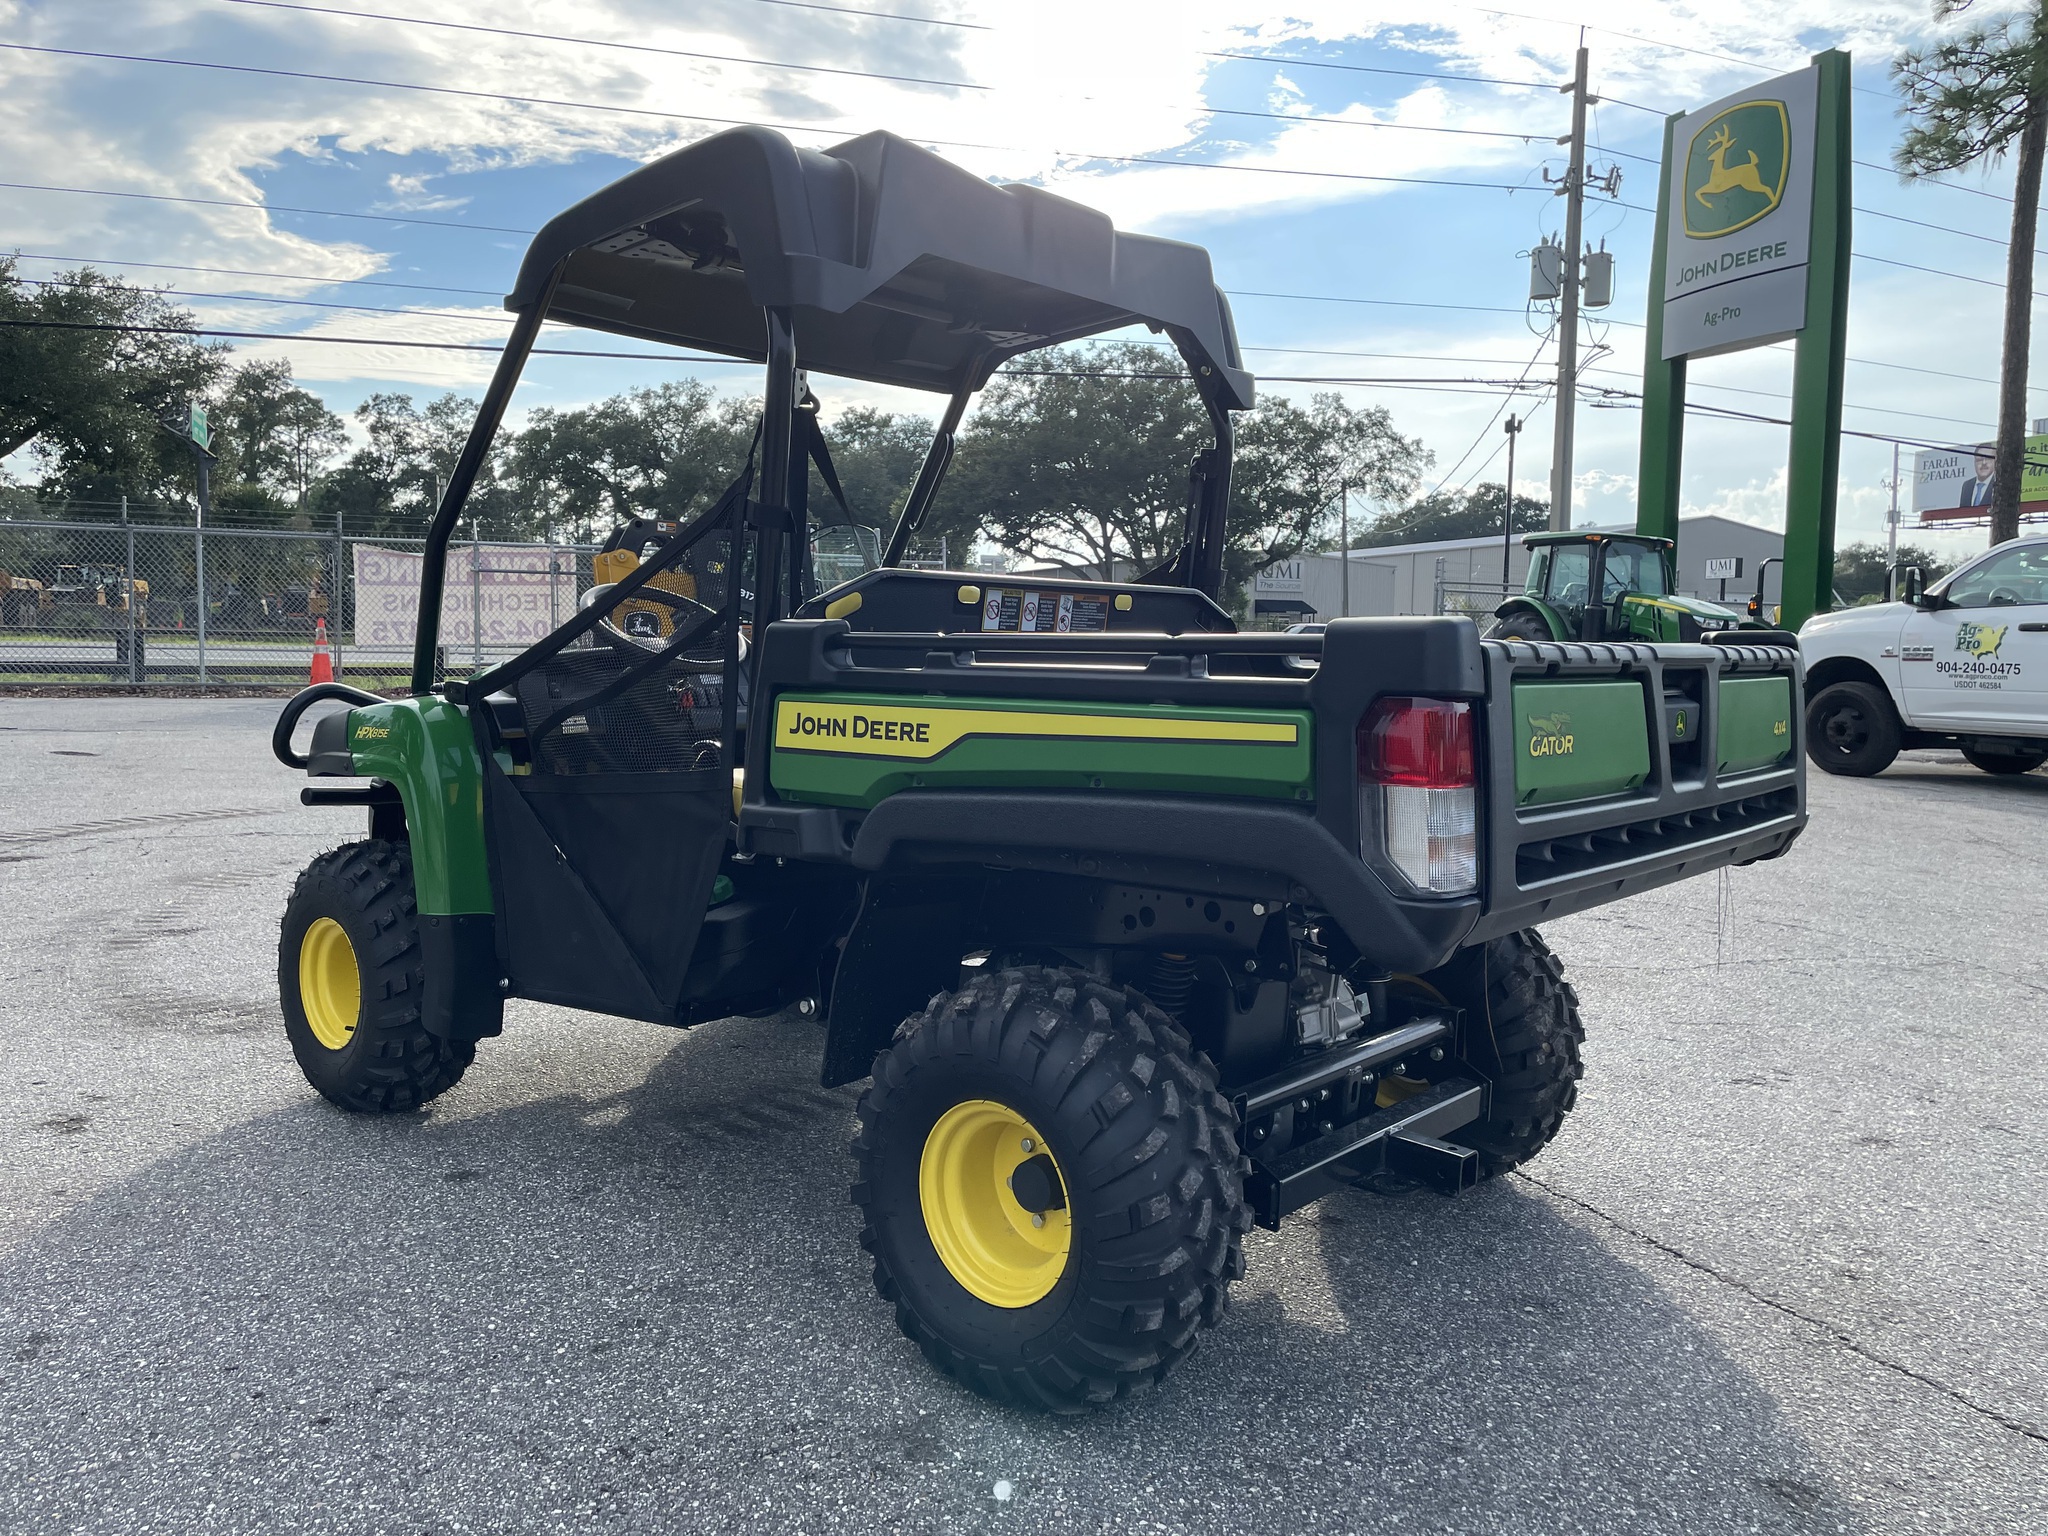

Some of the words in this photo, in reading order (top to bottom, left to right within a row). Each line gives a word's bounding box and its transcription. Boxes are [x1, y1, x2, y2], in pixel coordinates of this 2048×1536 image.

[1676, 260, 1717, 287] JOHN
[1720, 241, 1787, 272] DEERE
[1704, 307, 1741, 326] Ag-Pro
[1923, 457, 1958, 470] FARAH
[1710, 560, 1731, 571] UMI
[1260, 581, 1273, 589] The
[1954, 636, 1982, 652] Pro
[1936, 661, 2021, 675] 904-240-0475
[1954, 681, 1977, 689] USDOT
[1979, 681, 2002, 690] 462584
[789, 712, 847, 737] JOHN
[852, 715, 930, 743] DEERE
[1530, 735, 1574, 757] GATOR
